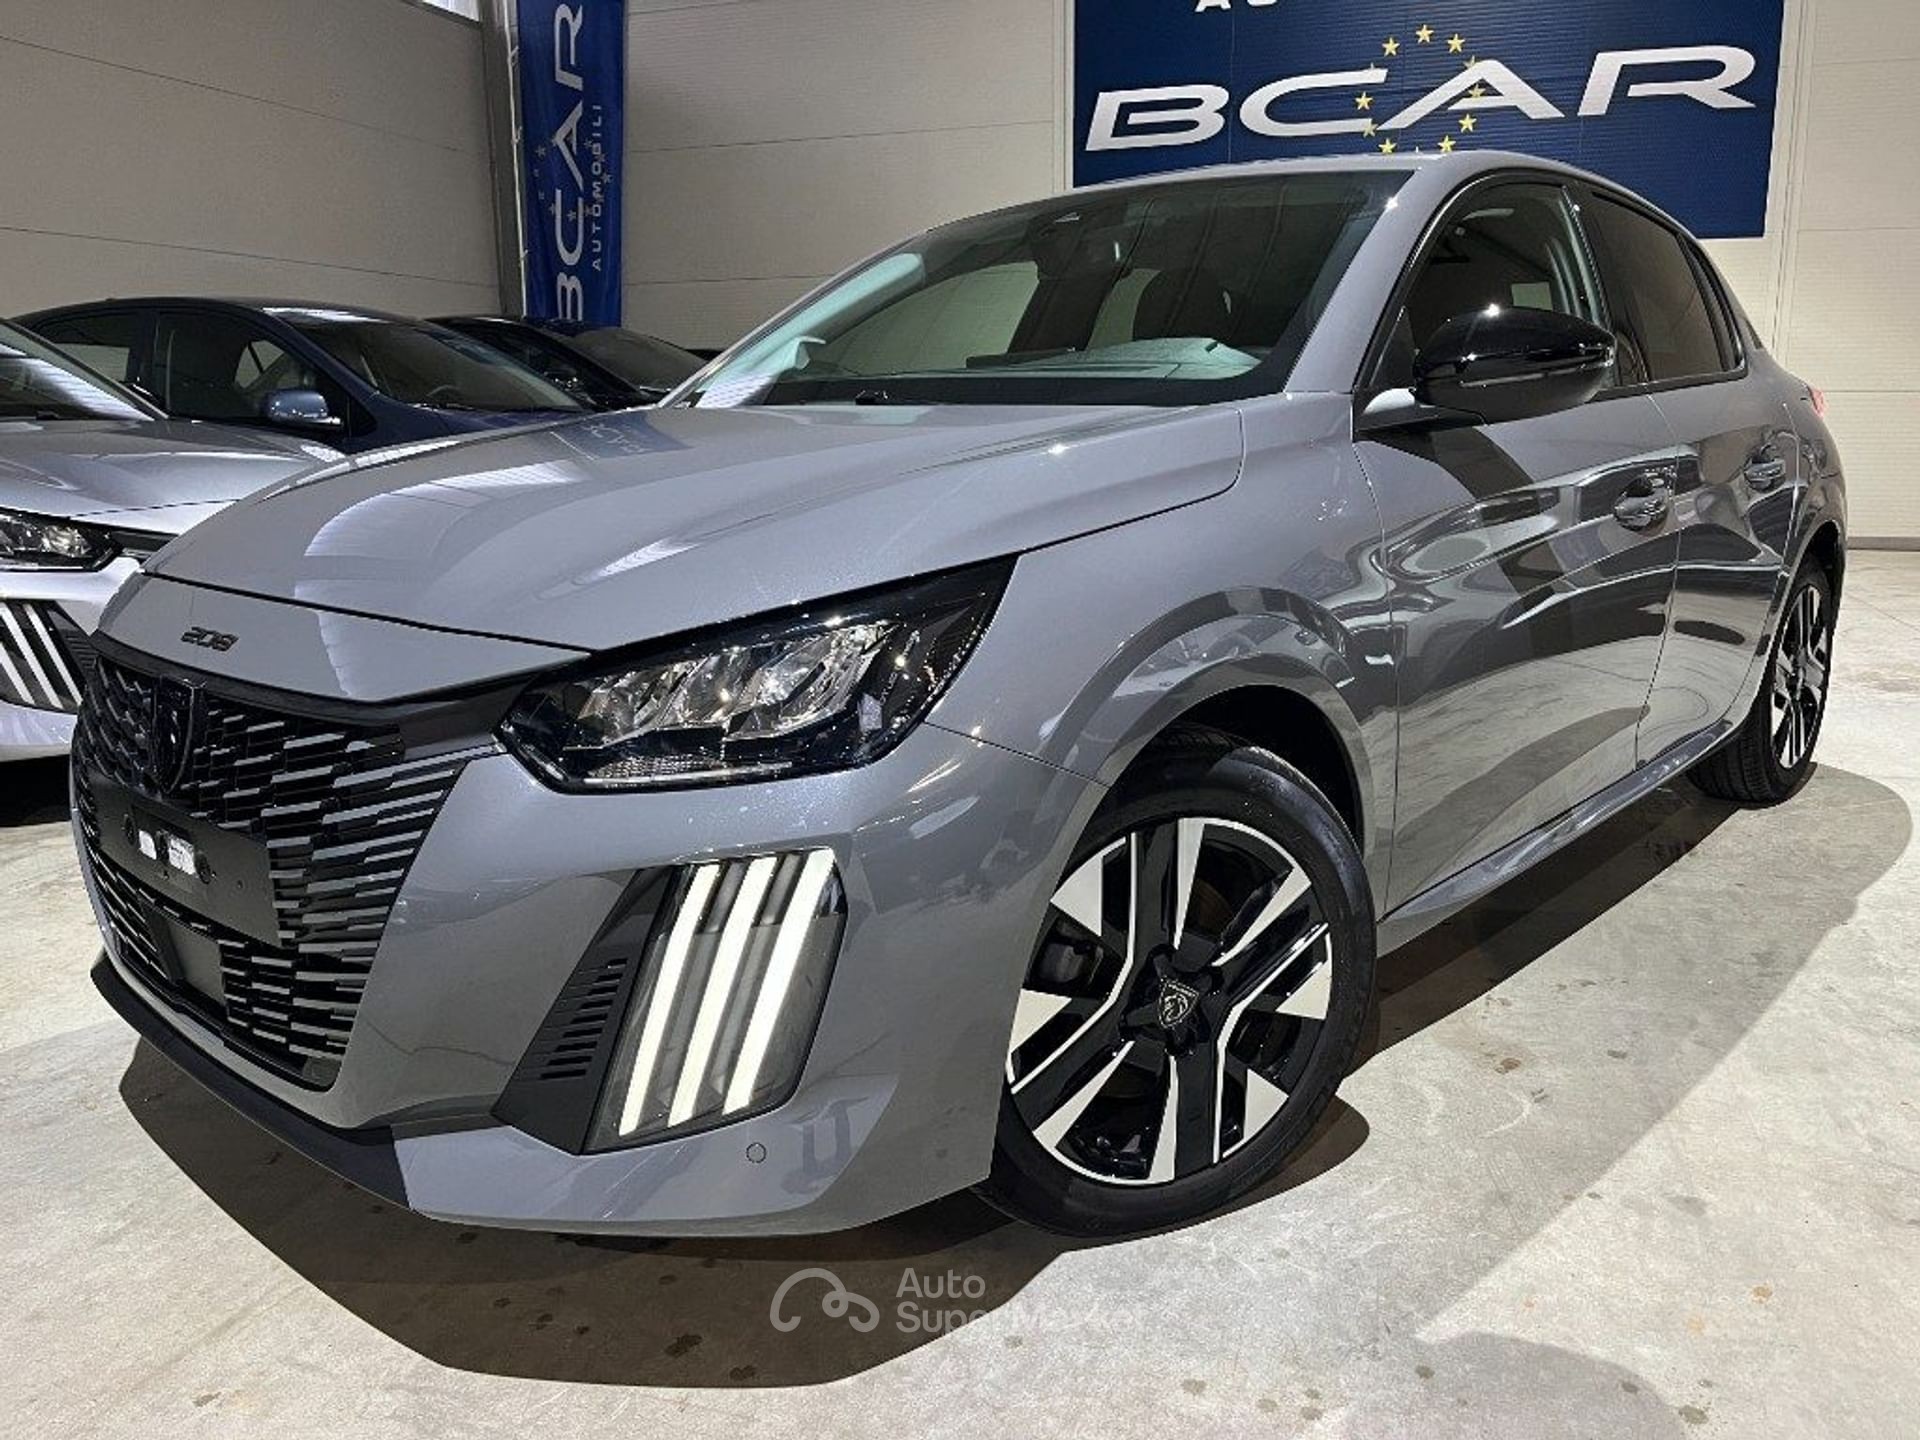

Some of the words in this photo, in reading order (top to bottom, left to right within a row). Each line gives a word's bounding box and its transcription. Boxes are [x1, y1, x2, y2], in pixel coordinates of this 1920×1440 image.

[554, 3, 584, 321] BCAR
[1085, 45, 1756, 151] BCAR
[591, 104, 602, 272] AUTOMOBILI
[180, 626, 239, 652] 208
